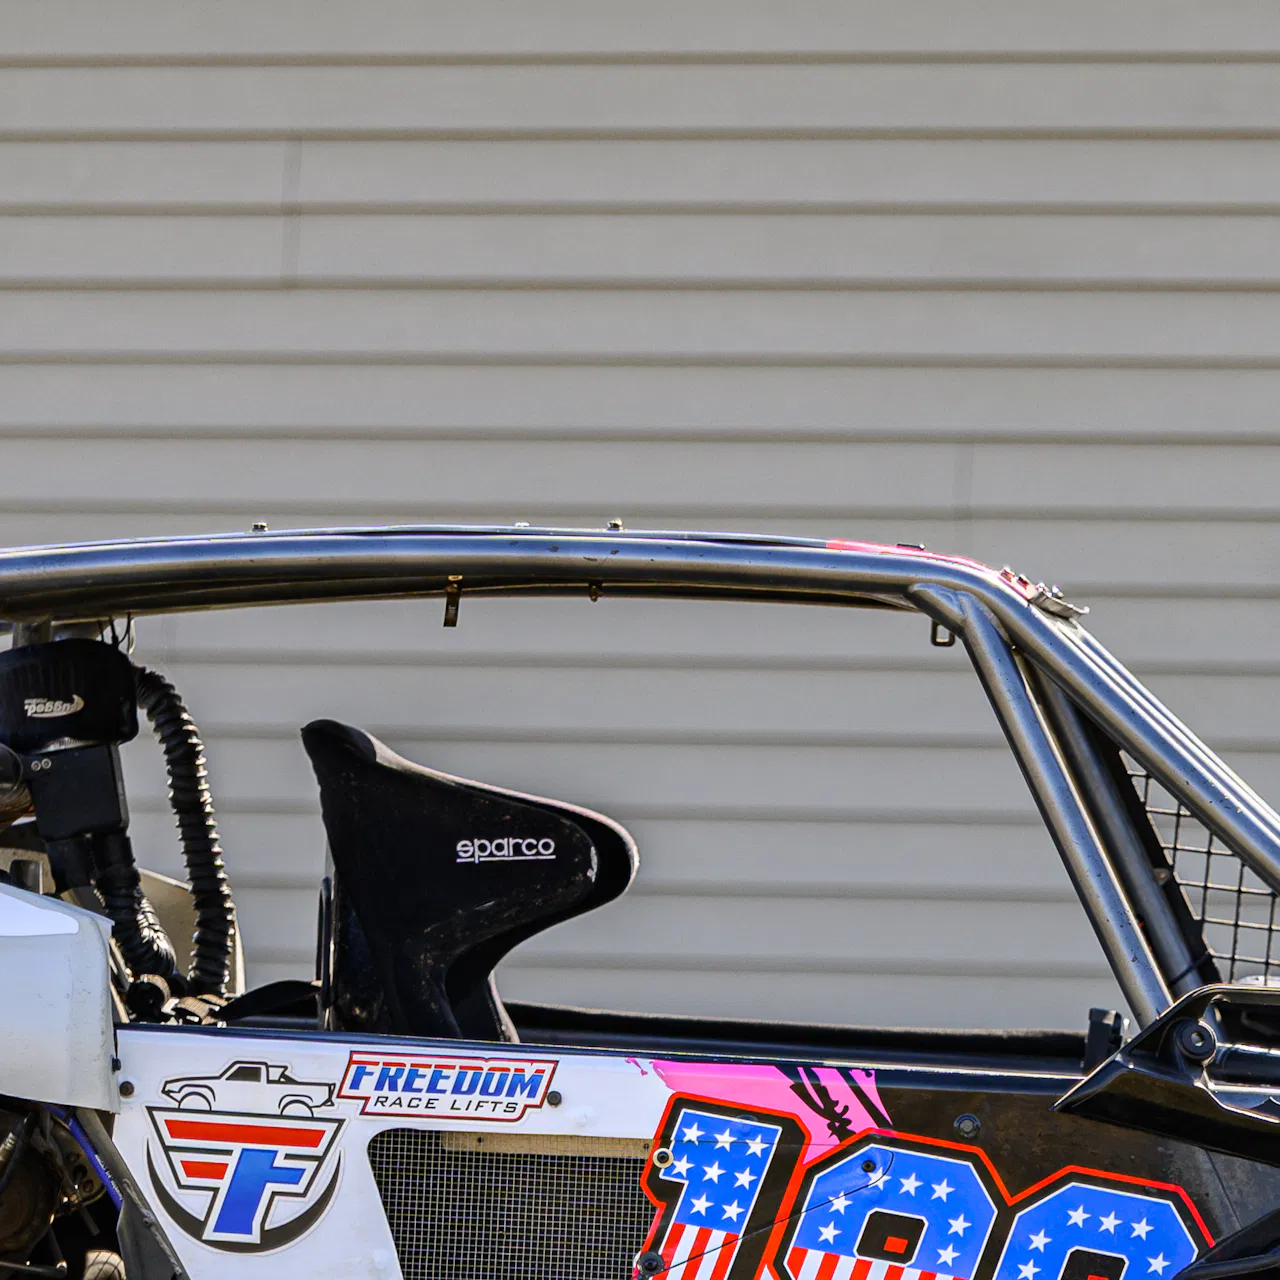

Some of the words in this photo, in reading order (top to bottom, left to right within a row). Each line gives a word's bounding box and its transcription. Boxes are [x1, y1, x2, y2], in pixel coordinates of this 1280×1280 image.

[456, 837, 556, 864] sparco
[349, 1060, 546, 1099] FREEDOM
[374, 1096, 437, 1110] RACE
[450, 1099, 519, 1114] LIFTS
